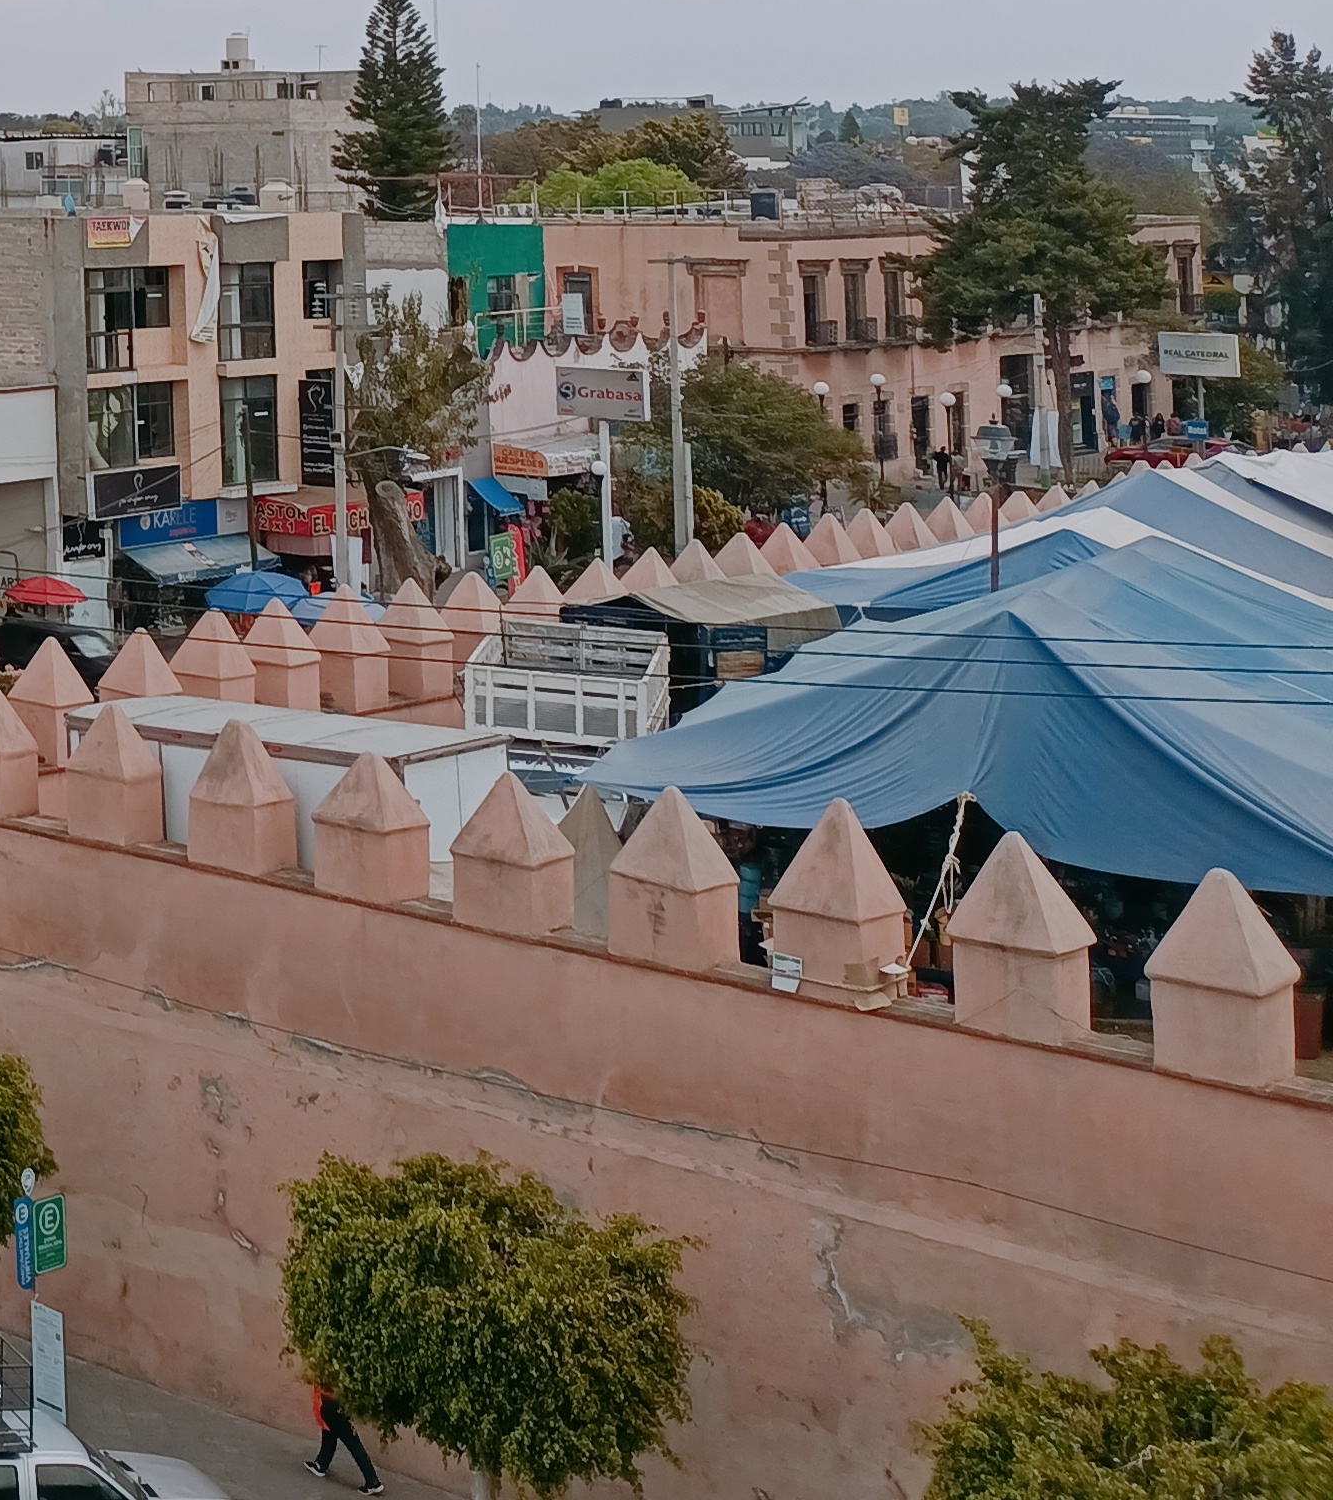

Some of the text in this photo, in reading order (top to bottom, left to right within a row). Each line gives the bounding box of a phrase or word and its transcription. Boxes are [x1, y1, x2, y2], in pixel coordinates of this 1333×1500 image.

[1163, 349, 1230, 359] REAL CATEDRAL
[577, 386, 643, 402] Grabasa
[254, 502, 309, 522] ASTOR
[259, 517, 269, 531] 2
[286, 520, 296, 534] 1
[312, 514, 331, 536] EL
